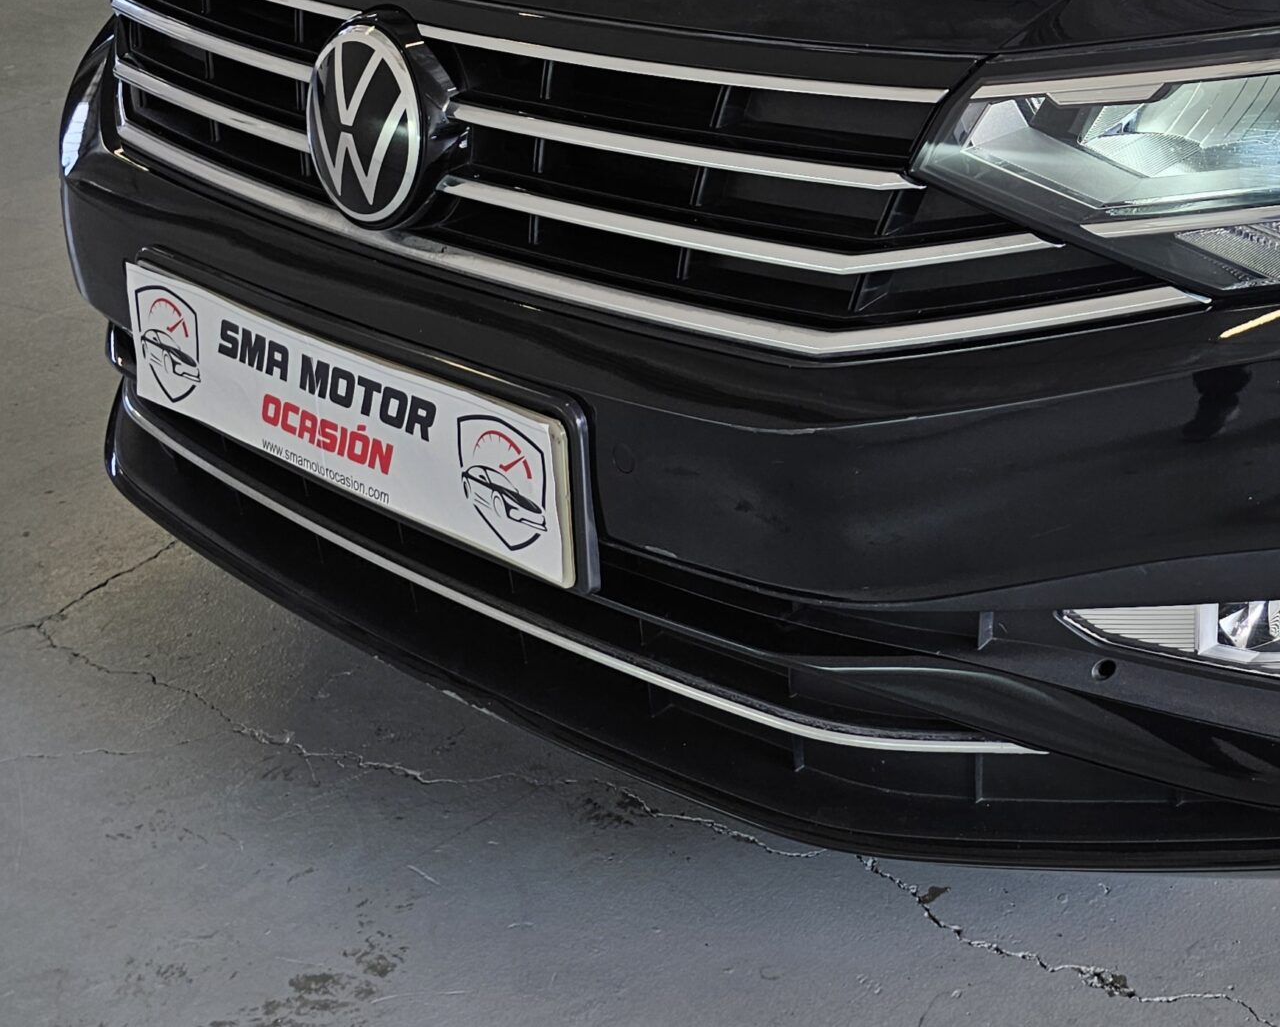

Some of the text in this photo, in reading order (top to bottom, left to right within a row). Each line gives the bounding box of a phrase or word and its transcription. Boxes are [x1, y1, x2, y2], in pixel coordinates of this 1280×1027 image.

[217, 318, 438, 443] SMA MOTOR
[261, 392, 395, 476] OCASIÓN
[261, 437, 391, 505] www.smamotorocasion.com
